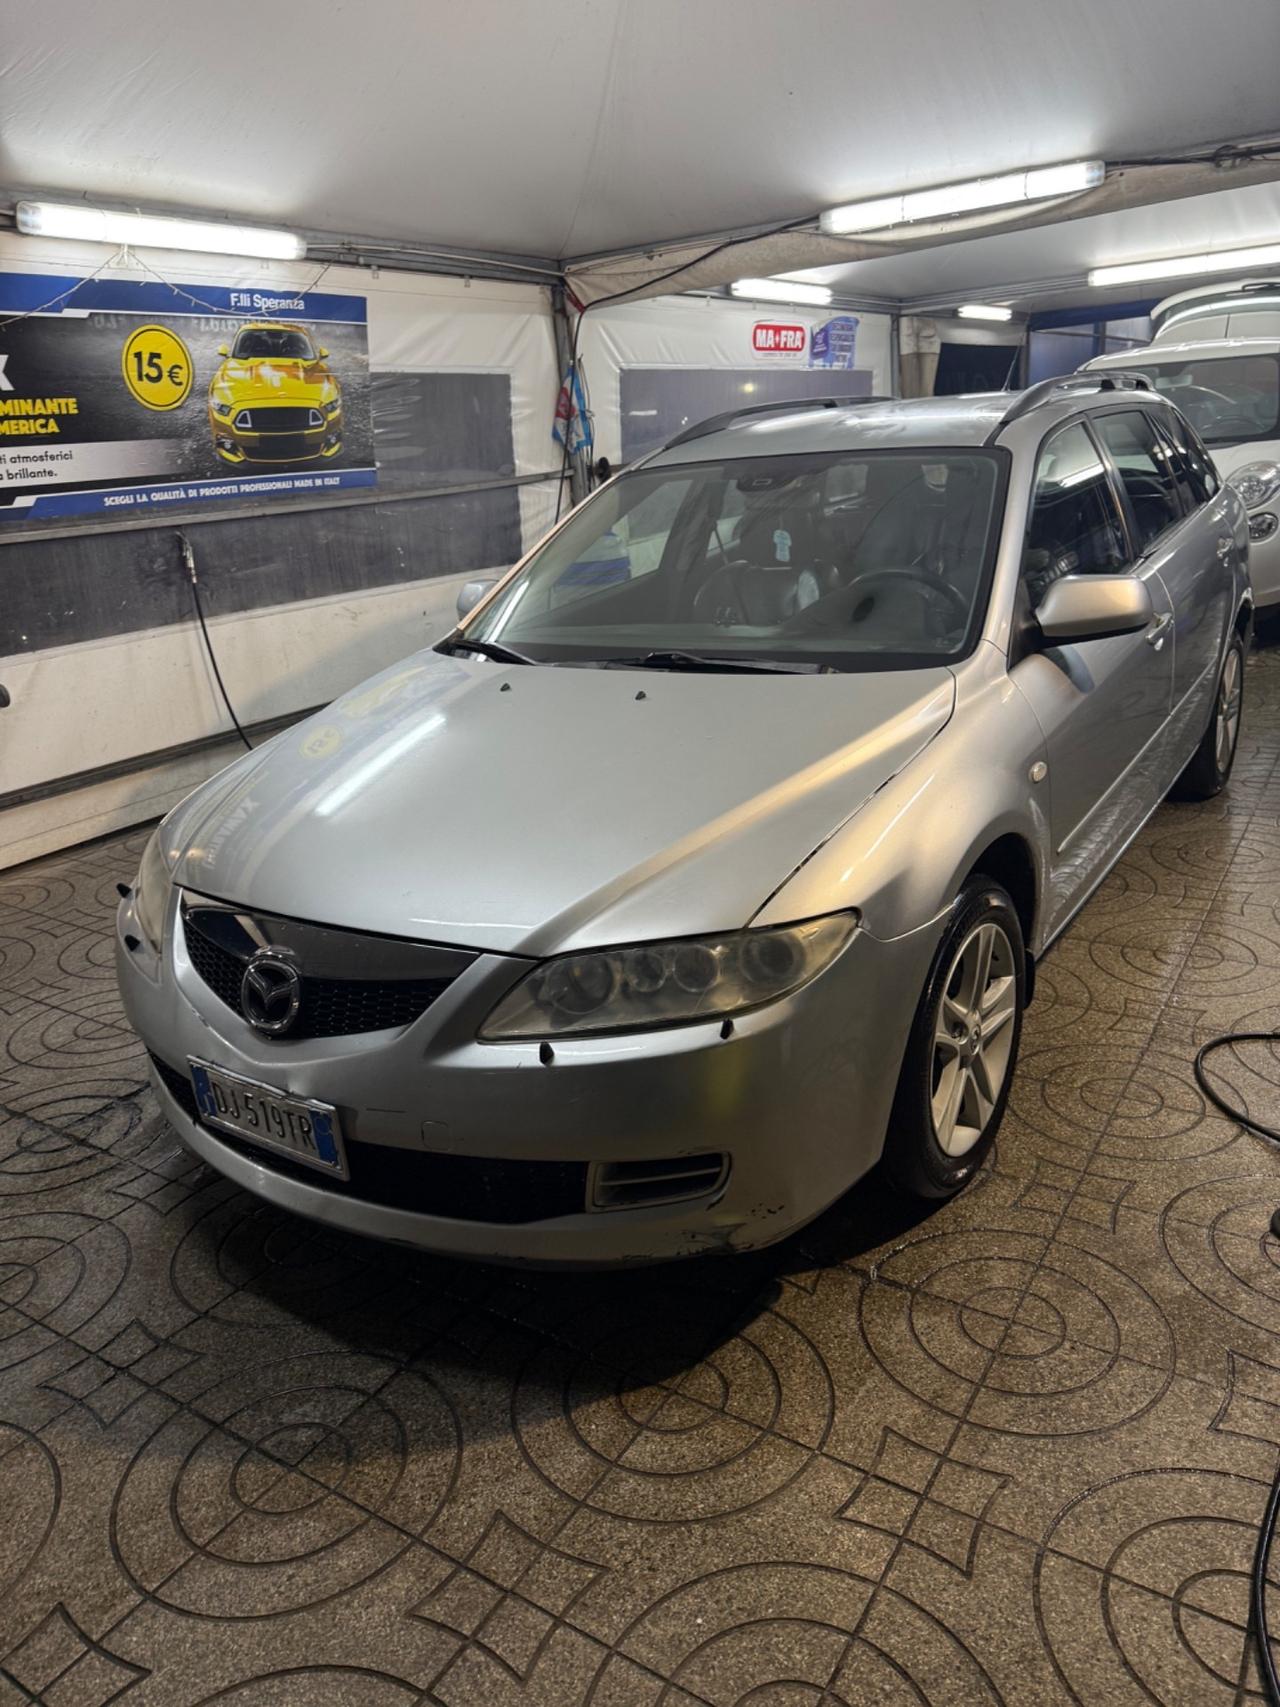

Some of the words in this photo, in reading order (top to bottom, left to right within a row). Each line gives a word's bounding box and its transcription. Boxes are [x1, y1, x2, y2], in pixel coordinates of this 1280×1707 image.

[252, 294, 306, 312] Speranza
[10, 450, 73, 464] atmosferici
[6, 467, 58, 481] brillante.
[104, 494, 134, 507] SCEGLI
[136, 493, 149, 503] LA
[151, 487, 186, 502] QUALITÀ
[188, 488, 198, 498] DI
[199, 484, 239, 497] PRODOTTI
[240, 479, 293, 493] PROFESSIONALI
[294, 478, 314, 488] MADE
[315, 477, 323, 487] IN
